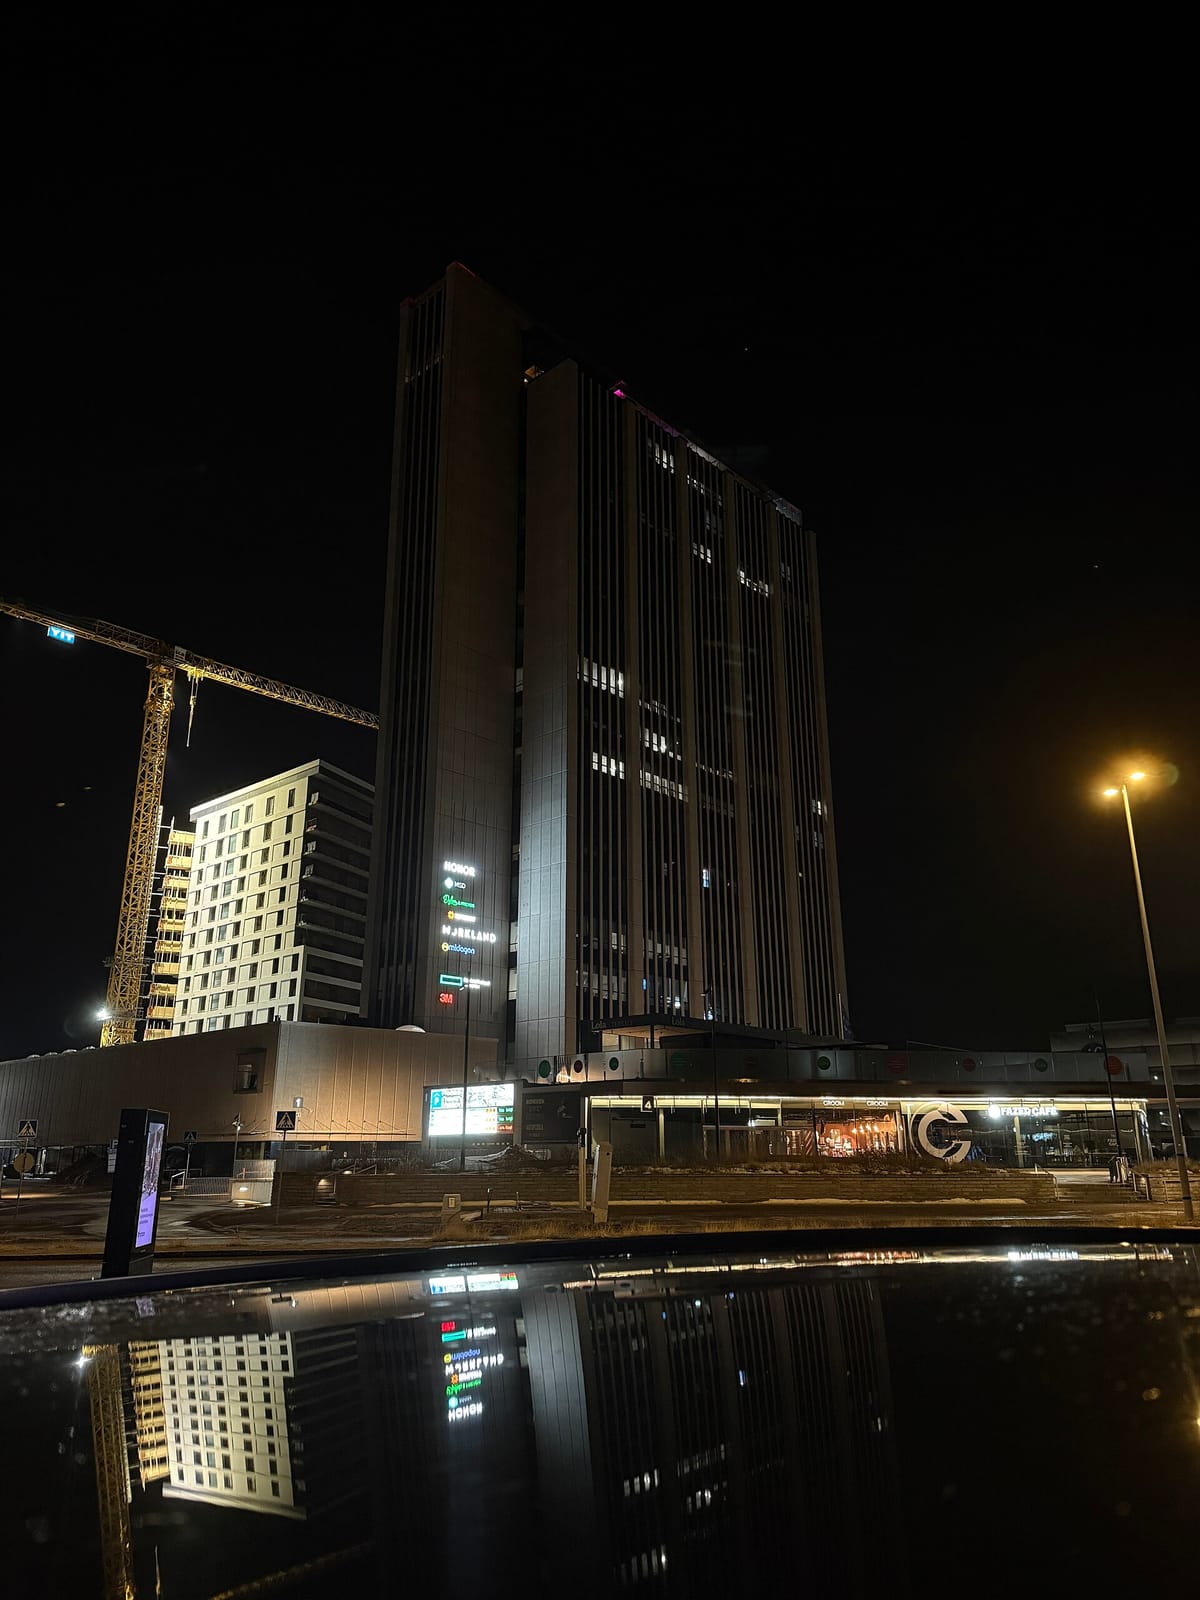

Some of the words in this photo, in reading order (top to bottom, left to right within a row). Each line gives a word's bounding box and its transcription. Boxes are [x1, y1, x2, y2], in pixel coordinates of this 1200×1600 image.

[50, 626, 74, 641] YIT
[443, 861, 476, 877] HONOR
[439, 992, 453, 1004] 3M
[644, 1100, 652, 1110] 4
[1001, 1107, 1031, 1116] FAZER
